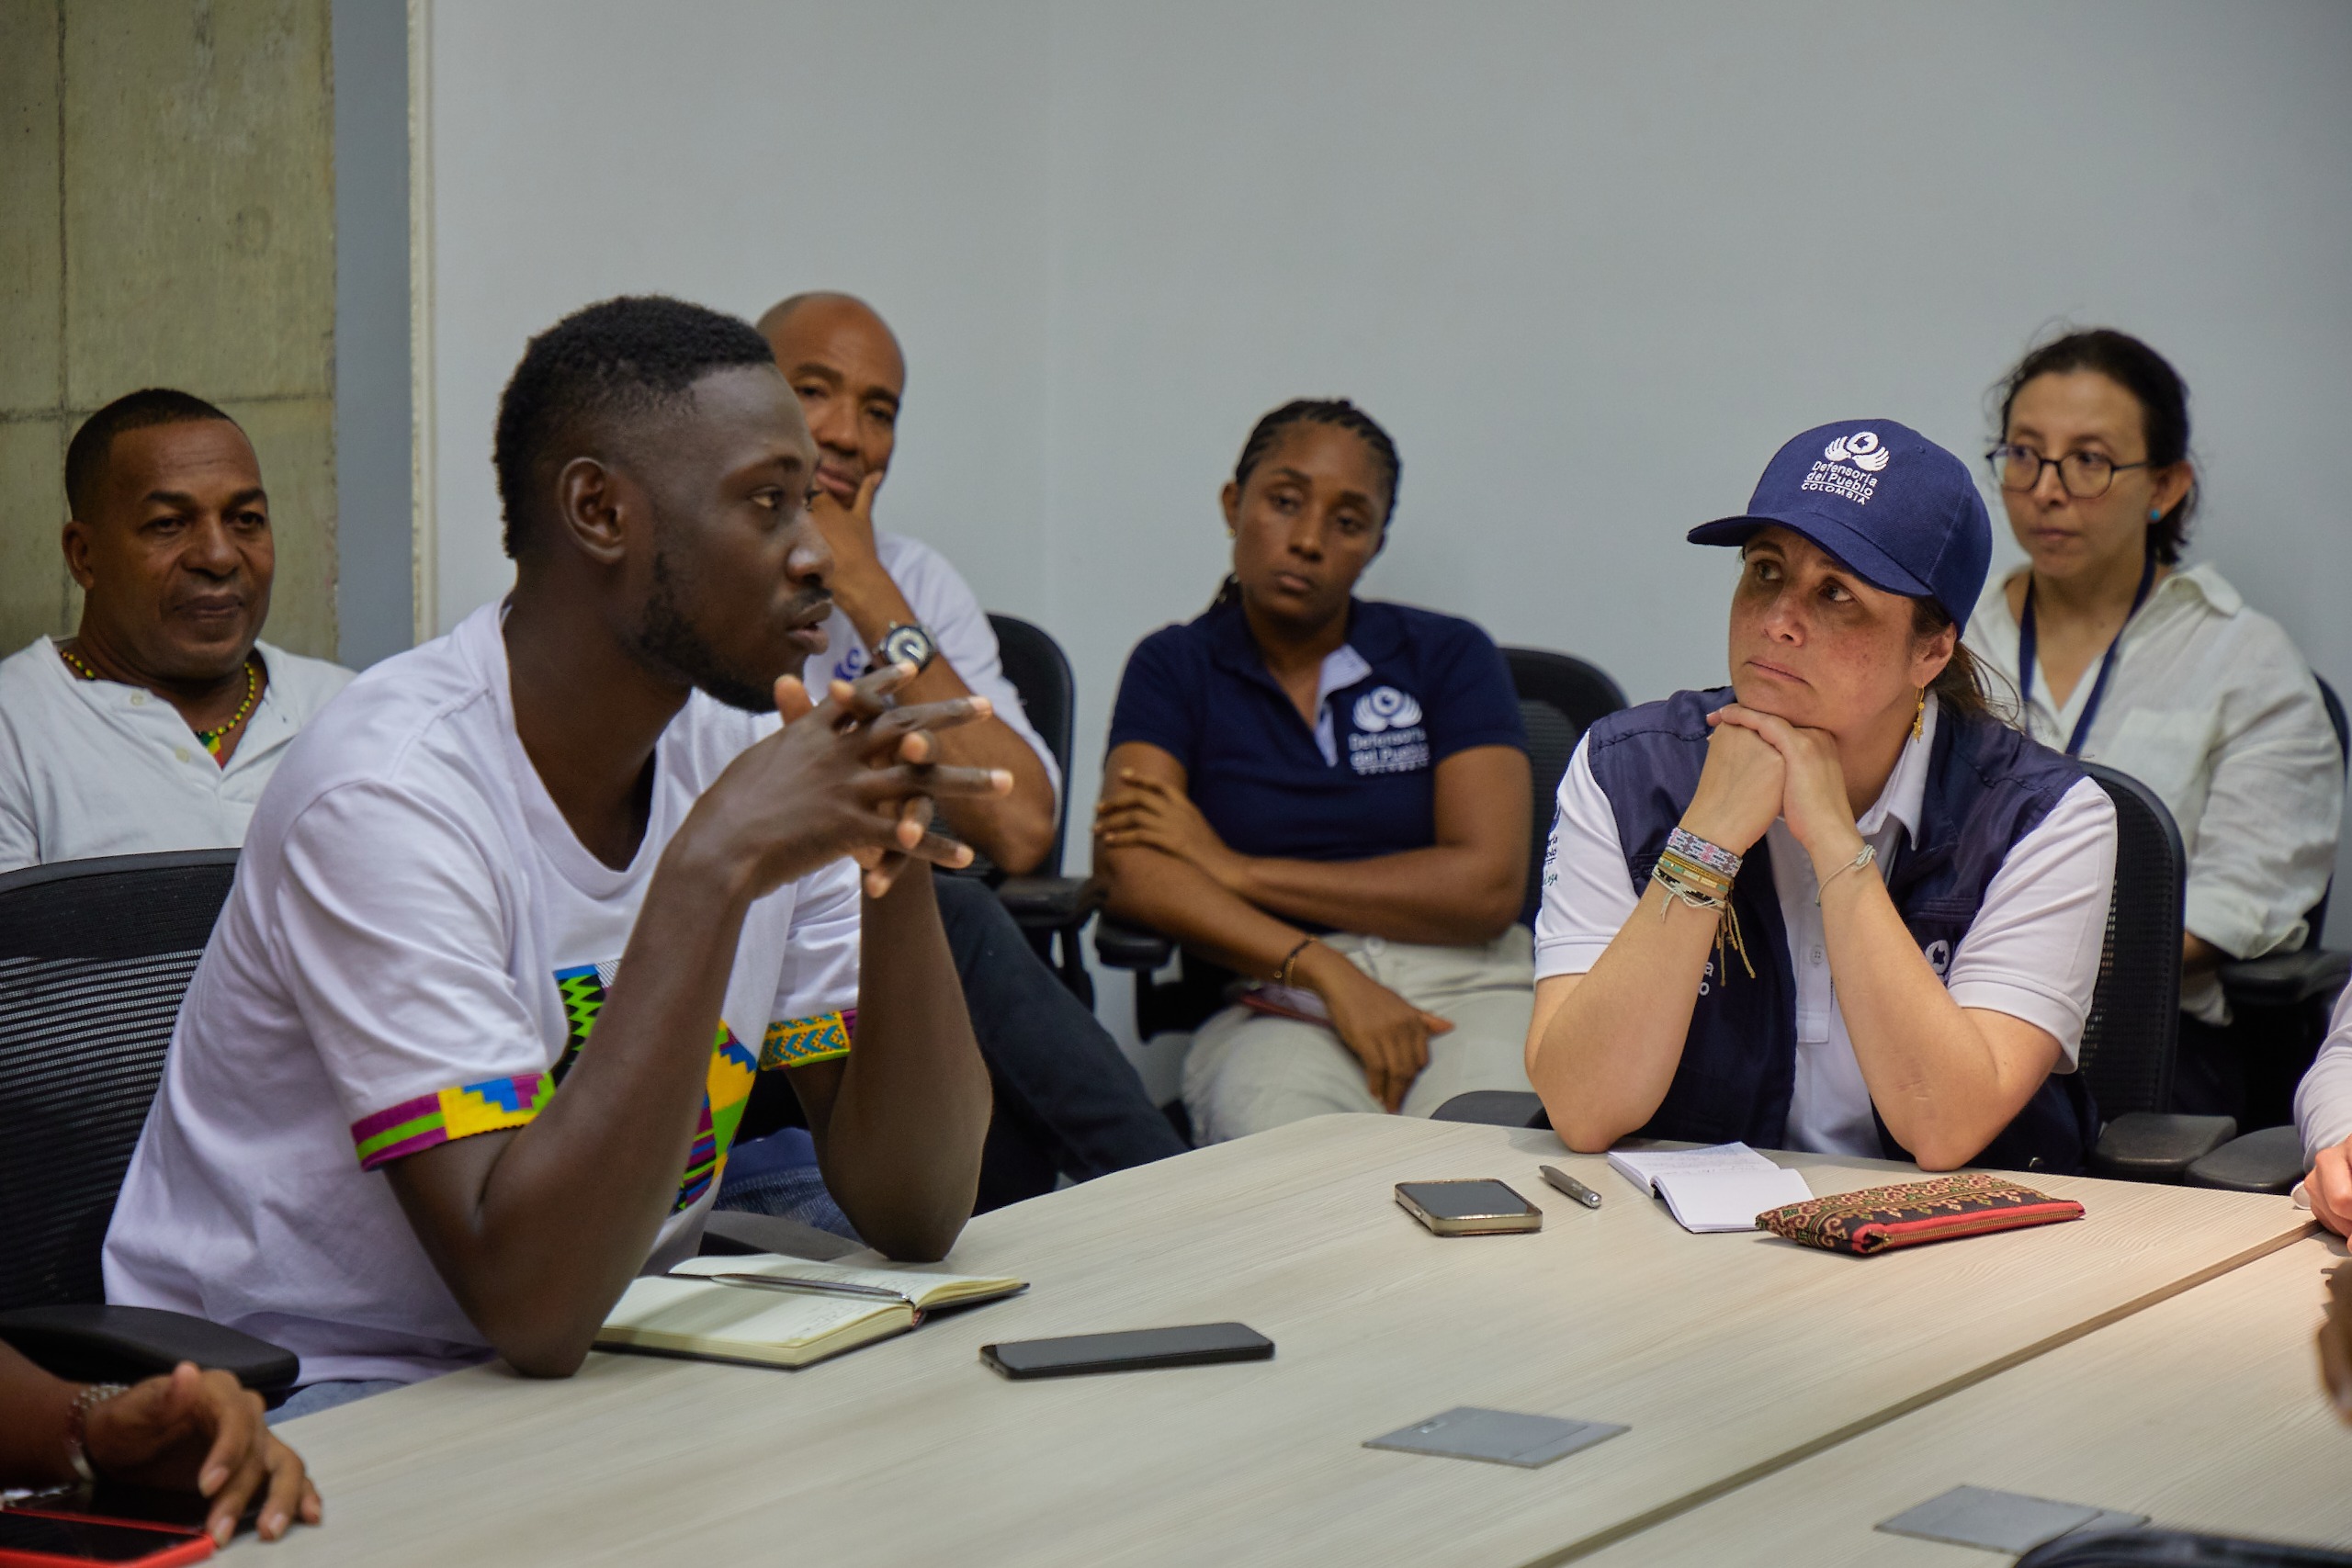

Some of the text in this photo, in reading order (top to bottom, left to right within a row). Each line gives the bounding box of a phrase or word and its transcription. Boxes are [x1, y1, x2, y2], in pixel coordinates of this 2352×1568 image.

[1806, 471, 1873, 497] del Pueblo
[1811, 460, 1878, 488] Defensoría
[1801, 482, 1866, 505] COLOMBIA
